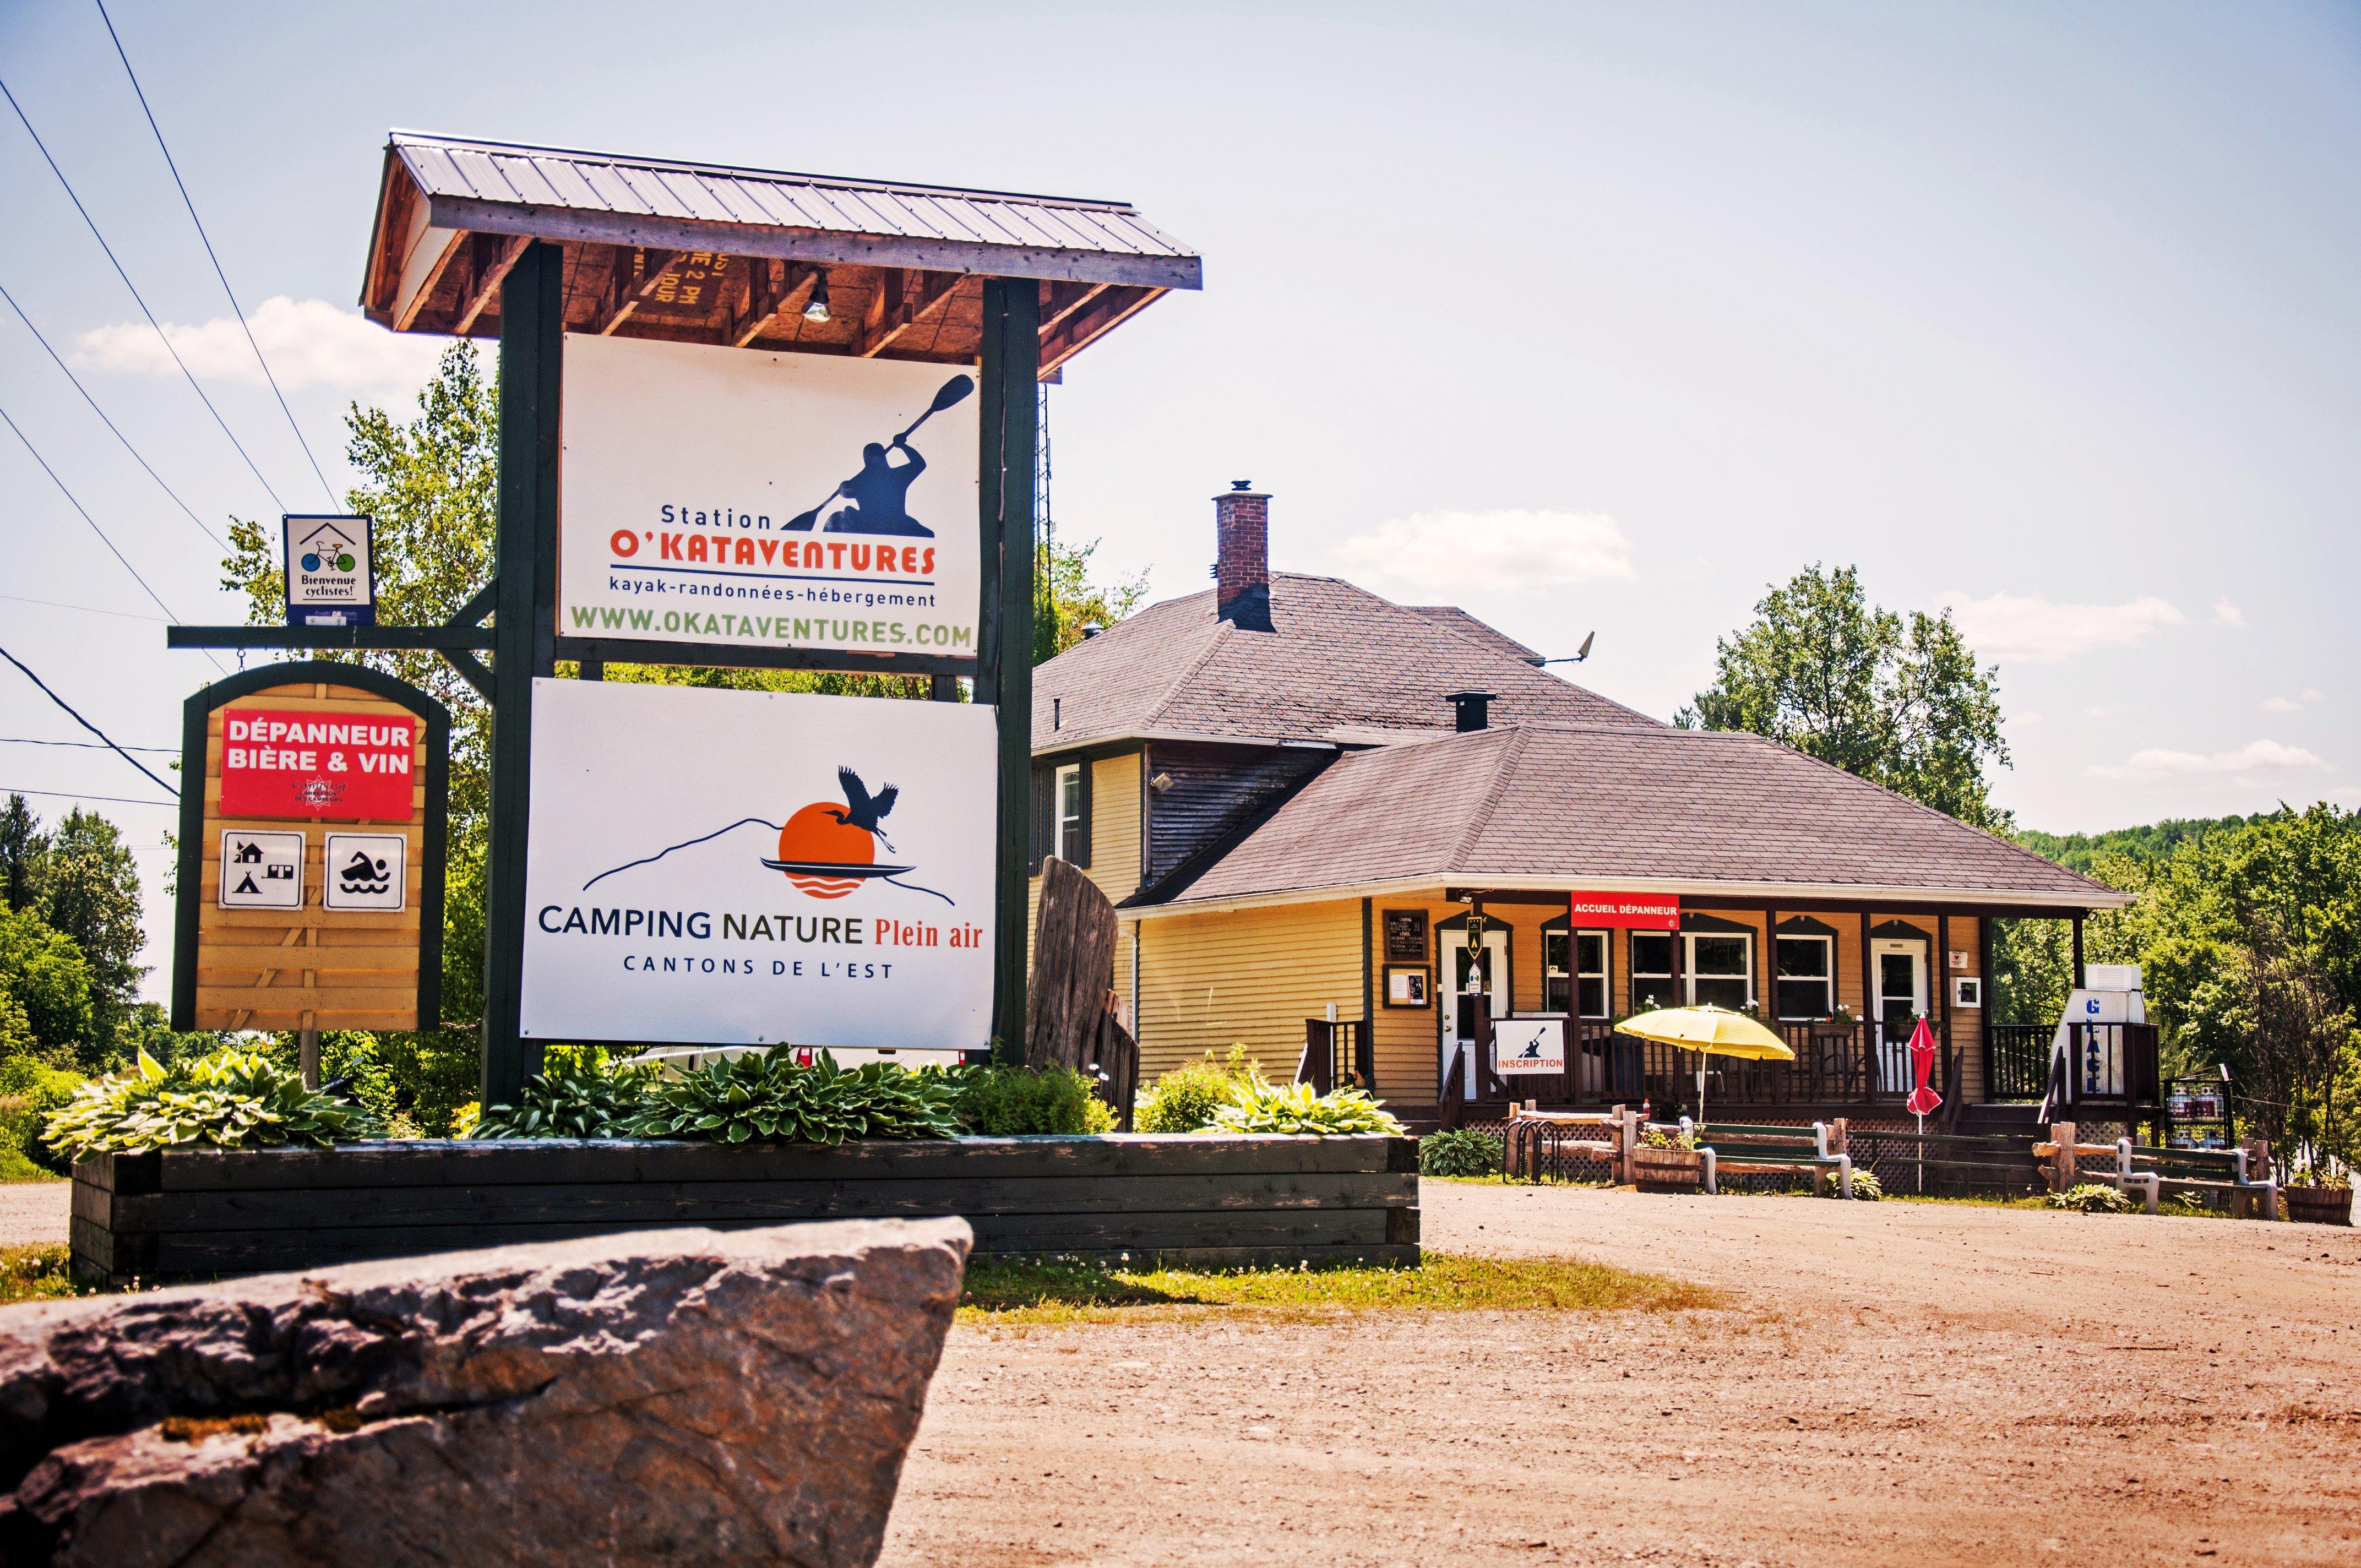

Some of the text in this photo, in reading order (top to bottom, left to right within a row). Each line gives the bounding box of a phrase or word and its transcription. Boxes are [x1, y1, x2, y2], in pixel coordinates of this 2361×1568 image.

[661, 504, 770, 530] Station
[610, 529, 935, 575] O'KATAVENTURES
[301, 575, 356, 585] Bienvenue
[306, 586, 353, 597] cyclistes!
[610, 576, 935, 607] kayak-randonnées-hébergement
[570, 606, 971, 648] WWW.OKATAVENTURES.COM
[229, 718, 410, 747] DÉPANNEUR
[228, 745, 409, 774] BIÈRE & VIN
[1574, 903, 1677, 916] ACCUEIL DÉPANNEUR
[538, 905, 983, 949] CAMPING NATURE Plein air
[624, 955, 893, 979] CANTONS DE L'EST
[1498, 1059, 1563, 1068] INSCRIPTION
